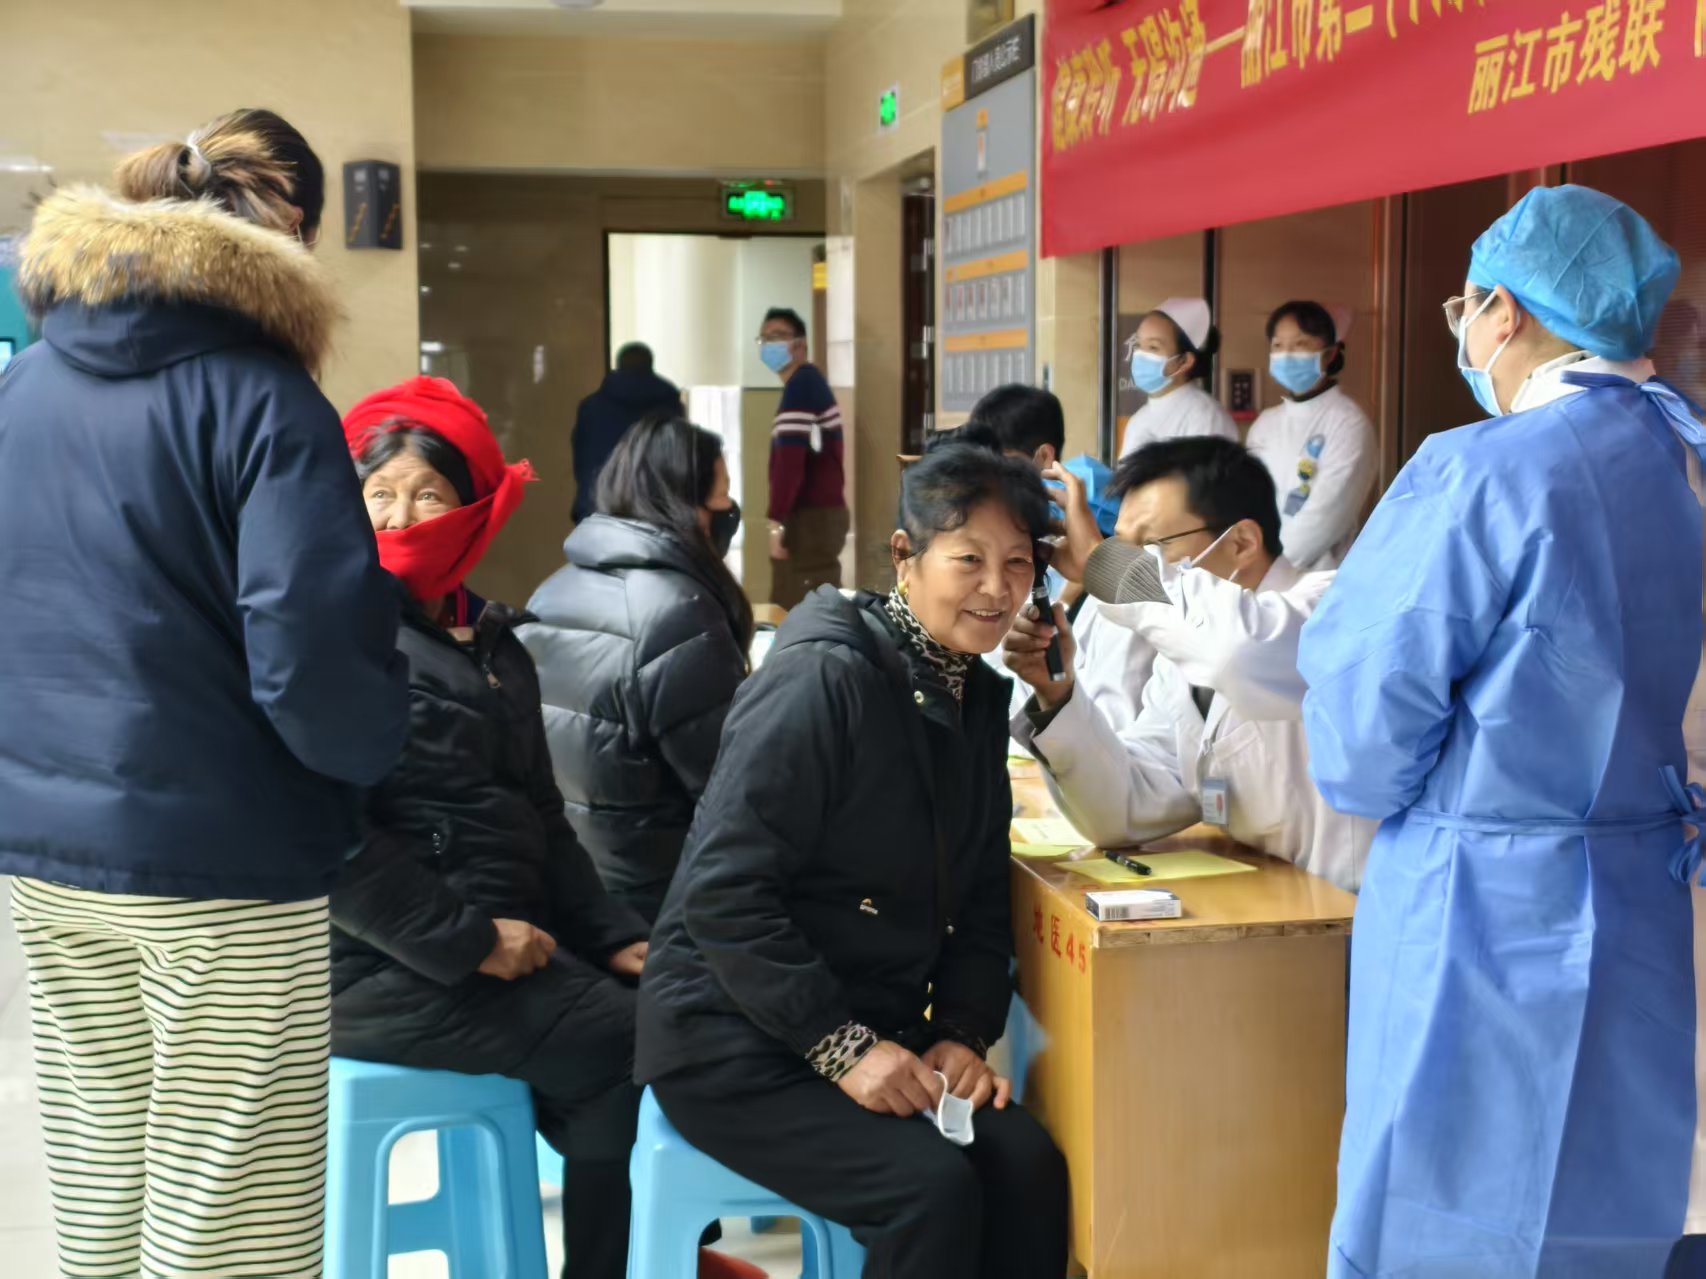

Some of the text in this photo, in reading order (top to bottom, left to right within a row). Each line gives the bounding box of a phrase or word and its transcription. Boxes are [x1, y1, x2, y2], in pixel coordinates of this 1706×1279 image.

[1467, 0, 1665, 115] 丽江市残联
